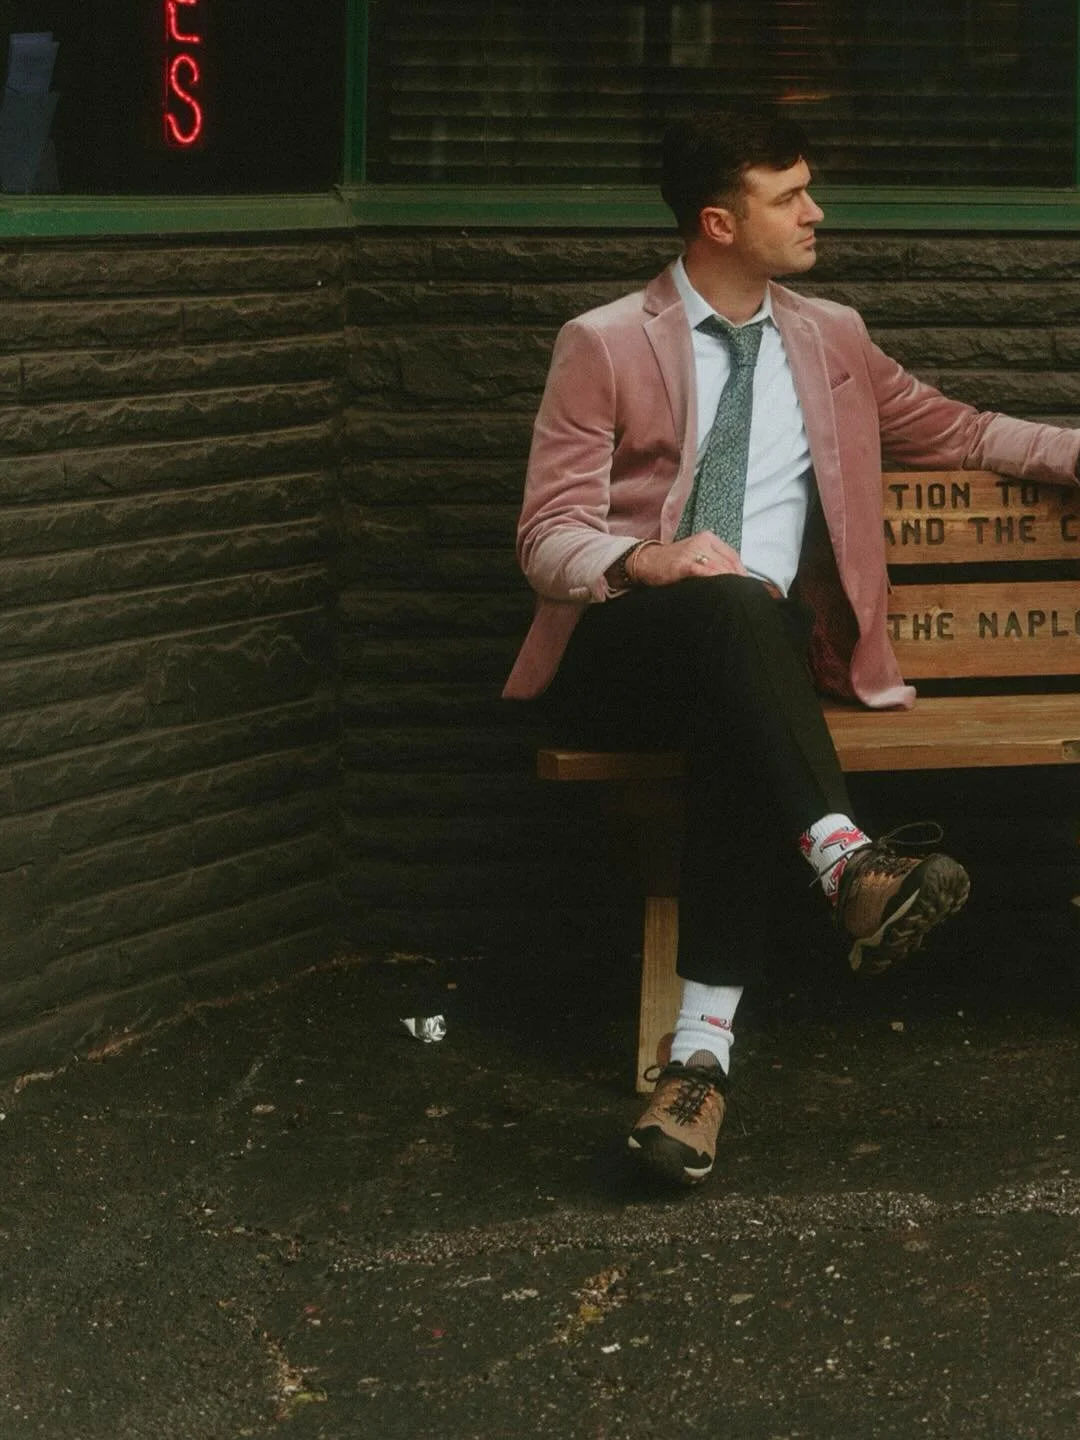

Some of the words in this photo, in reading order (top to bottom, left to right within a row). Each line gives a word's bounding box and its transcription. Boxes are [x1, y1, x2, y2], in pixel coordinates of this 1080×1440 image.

[995, 480, 1040, 507] TO
[967, 515, 1036, 545] THE
[886, 612, 954, 641] THE
